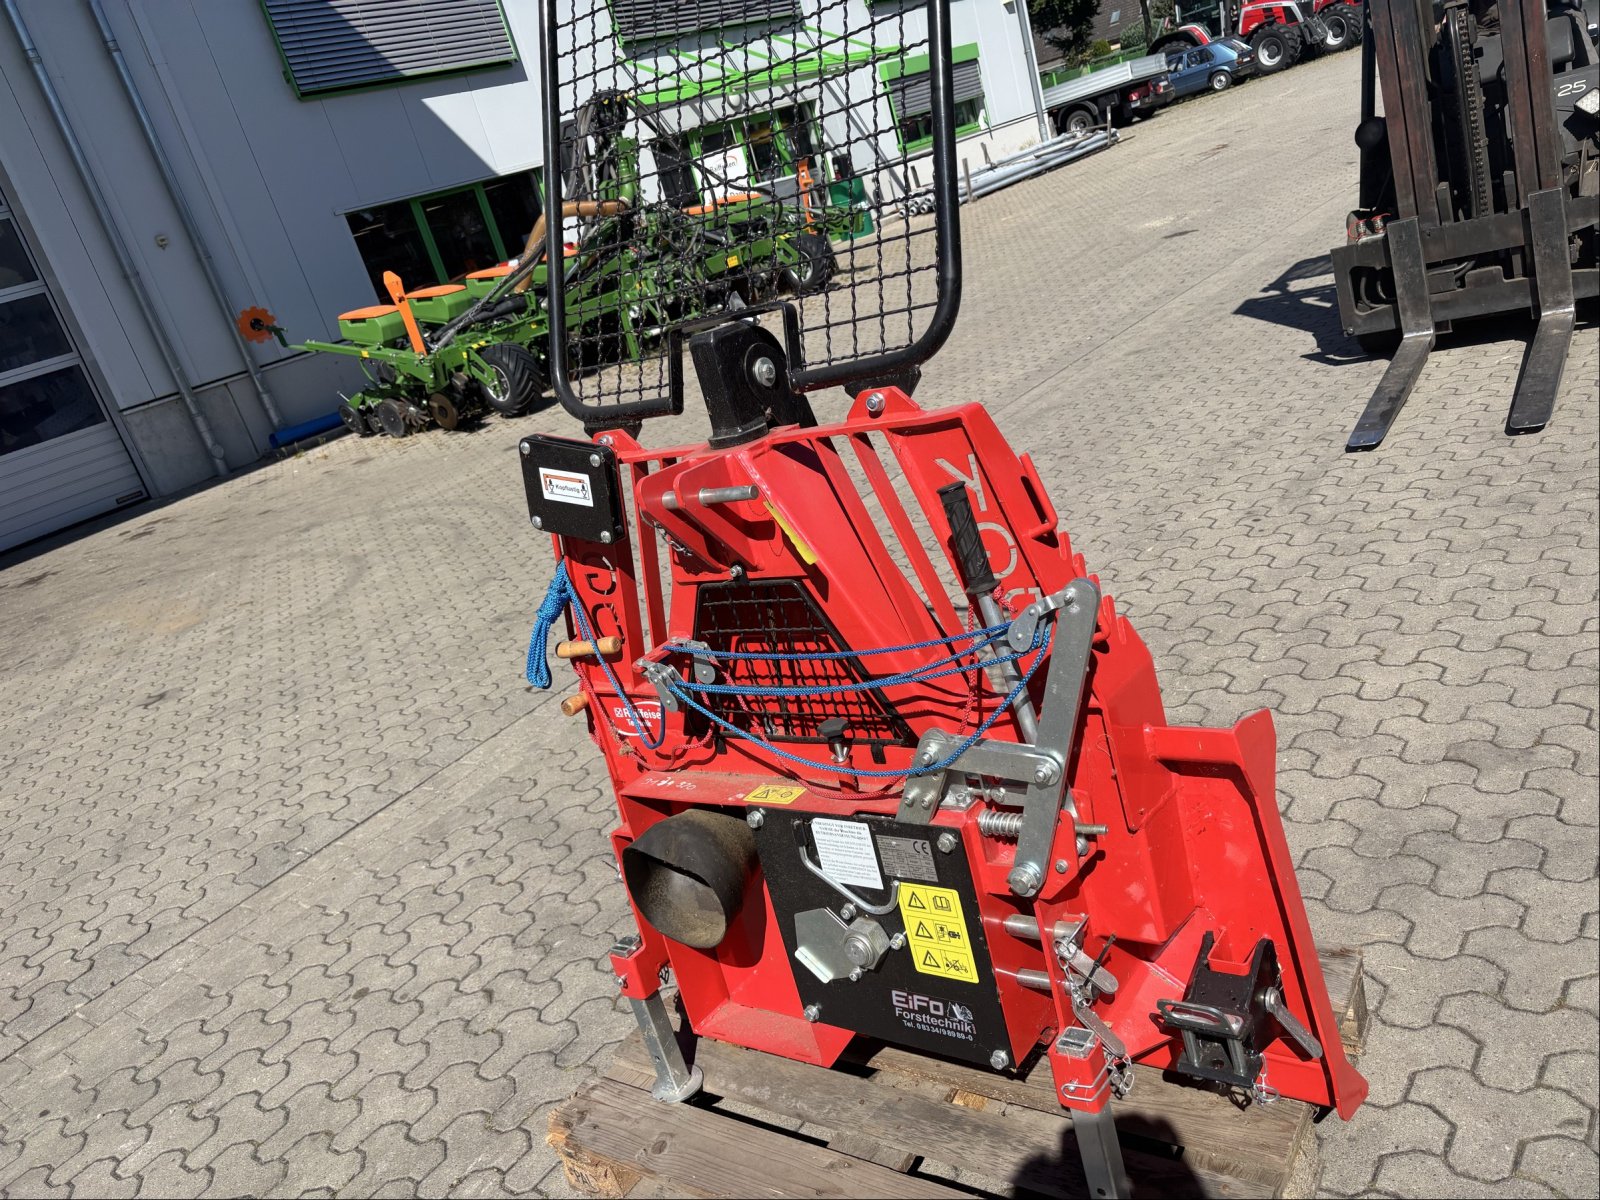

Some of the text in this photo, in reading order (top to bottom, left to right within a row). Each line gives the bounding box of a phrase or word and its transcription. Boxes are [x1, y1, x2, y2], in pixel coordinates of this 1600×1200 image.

[1557, 79, 1587, 97] 25
[622, 707, 662, 720] Riffeise
[912, 840, 930, 855] CE
[891, 989, 944, 1016] EiFo
[895, 1007, 973, 1033] Forsttechnik
[902, 1019, 915, 1028] Tel.
